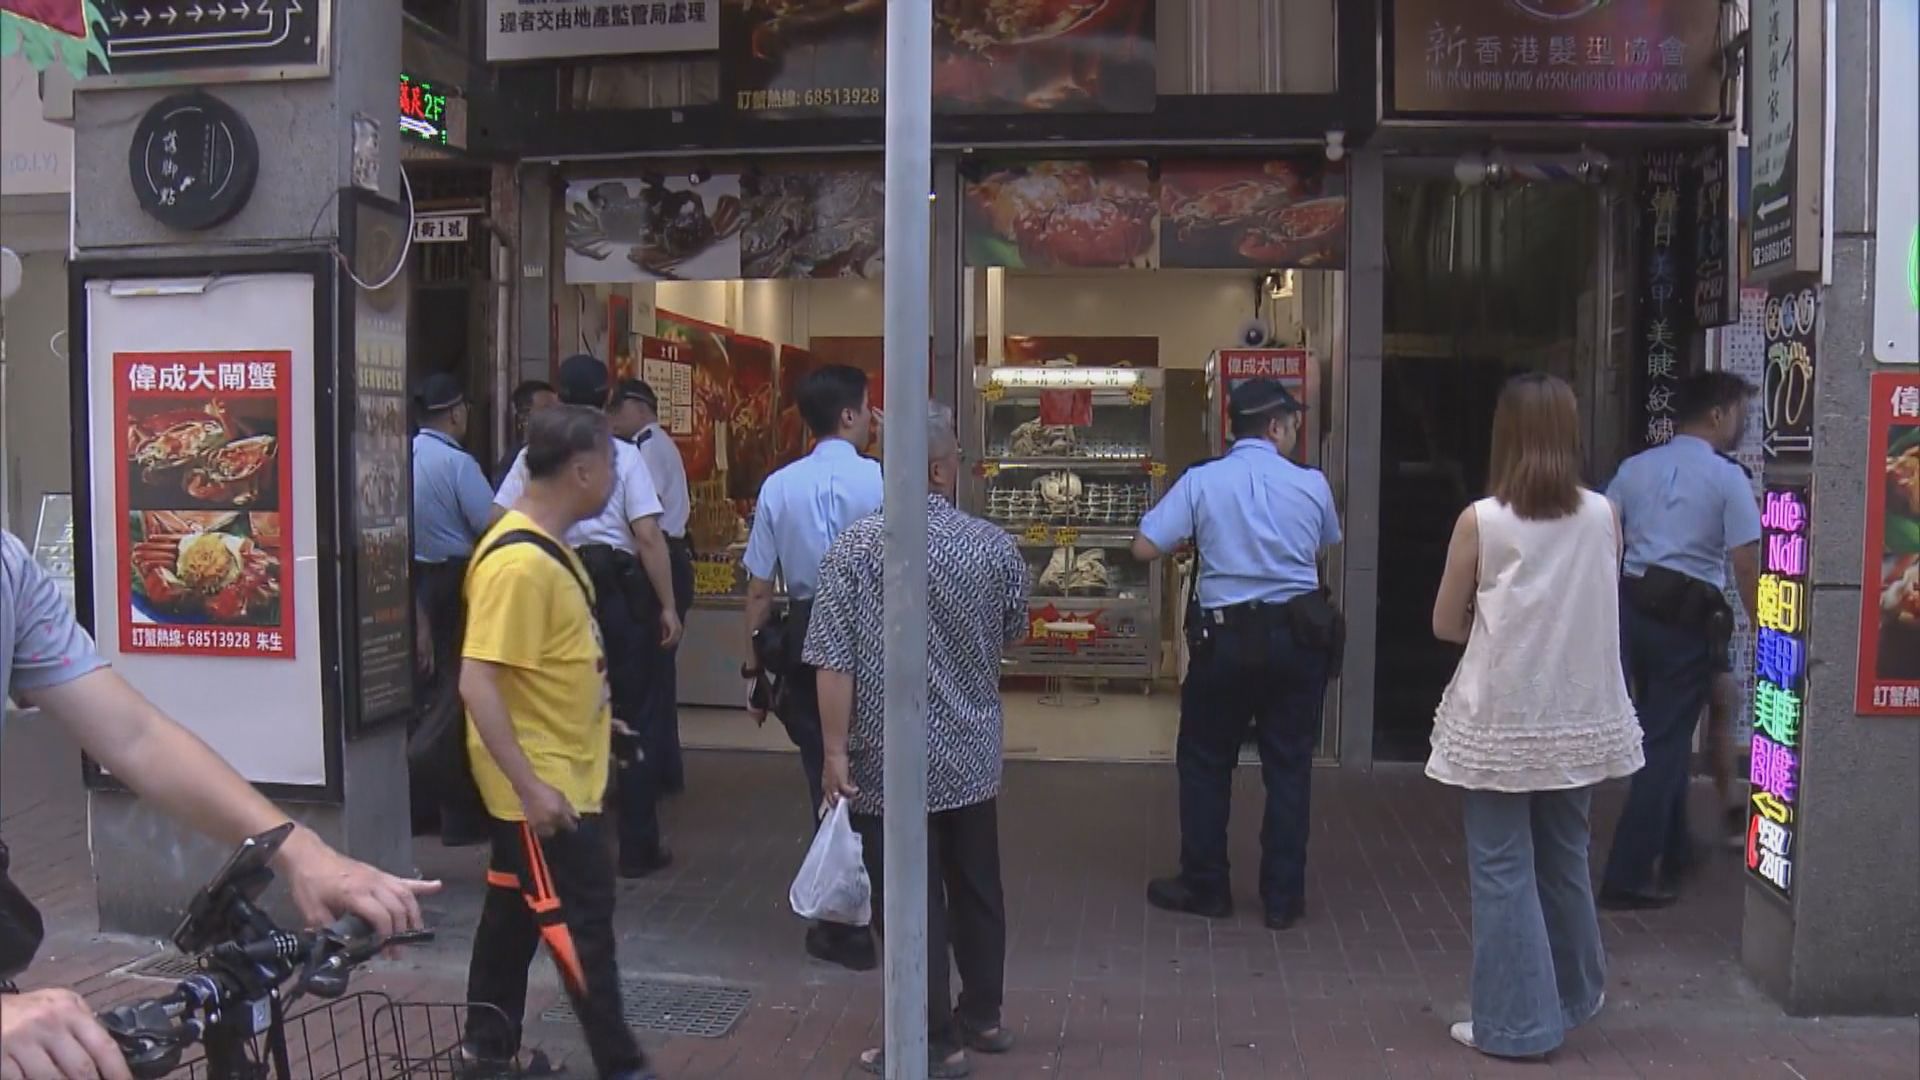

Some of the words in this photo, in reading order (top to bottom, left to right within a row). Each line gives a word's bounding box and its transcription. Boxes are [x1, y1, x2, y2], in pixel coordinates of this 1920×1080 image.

[500, 2, 706, 33] 違者交由地產監管局處理
[1425, 20, 1688, 68] 新香港髮型協會
[804, 87, 880, 106] 68513928
[405, 220, 464, 239] 街1號
[129, 361, 277, 391] 偉成大閘蟹
[187, 629, 251, 648] 68513928
[256, 631, 283, 651] 朱生
[1756, 627, 1801, 690] 美甲
